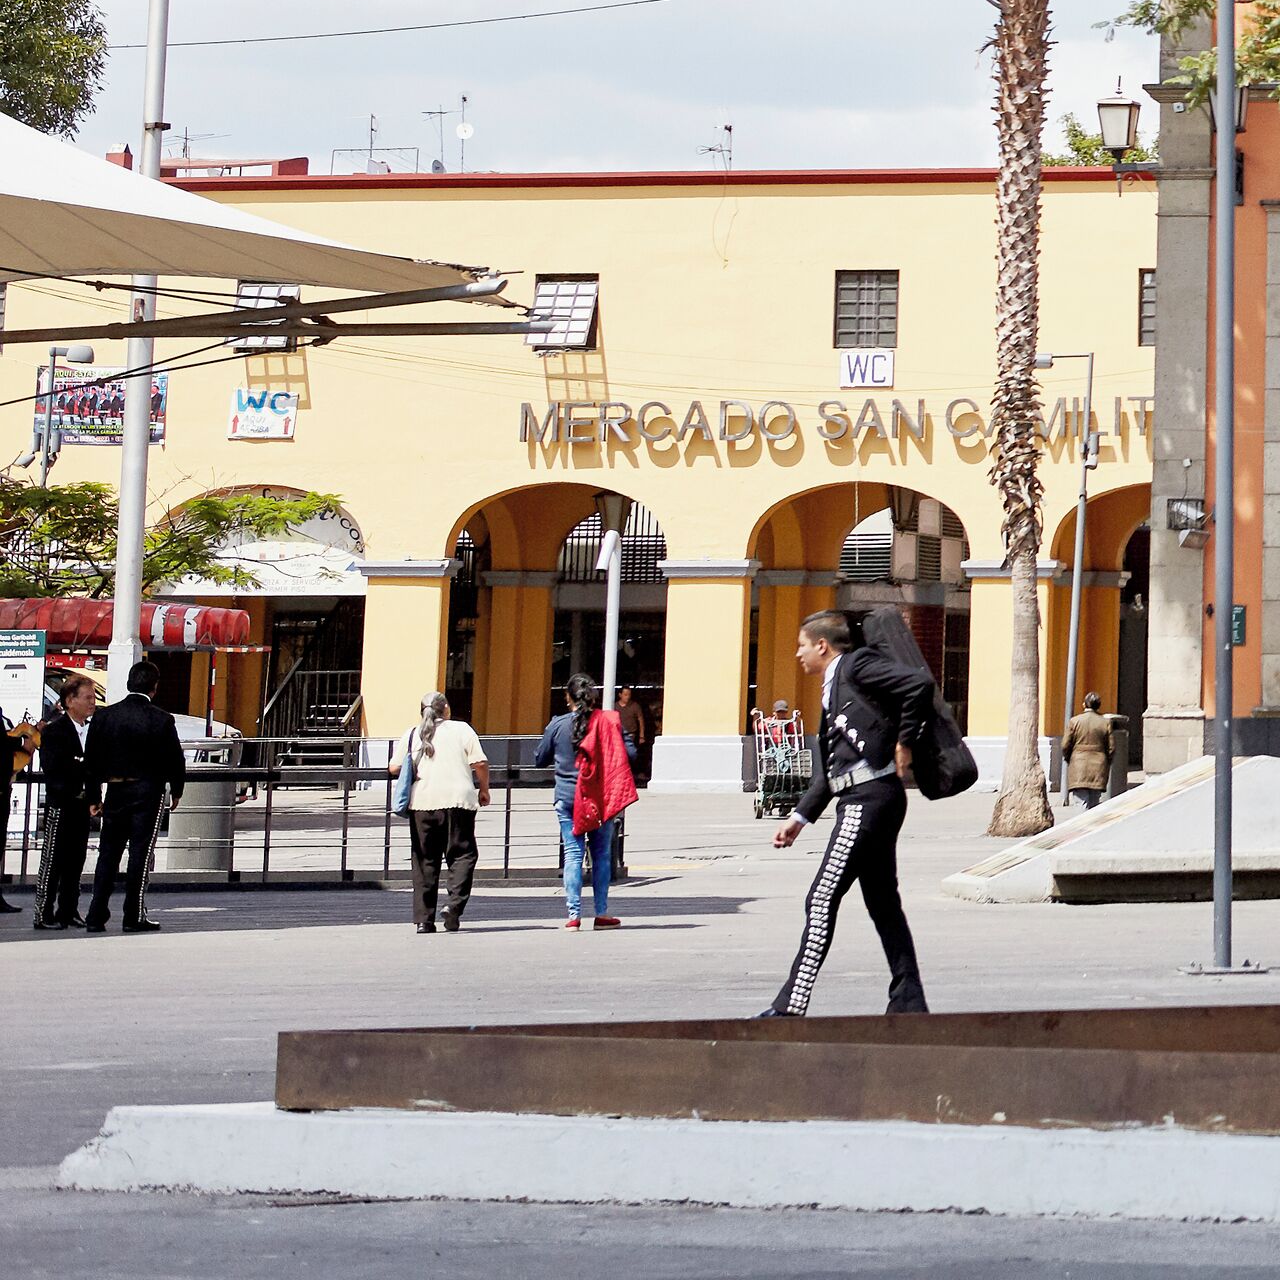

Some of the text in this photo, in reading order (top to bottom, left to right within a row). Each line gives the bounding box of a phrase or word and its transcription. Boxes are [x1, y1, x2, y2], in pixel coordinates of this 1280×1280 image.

[847, 354, 887, 383] WC
[237, 388, 290, 415] WC
[519, 400, 797, 442] MERCADO
[816, 398, 925, 440] SAN
